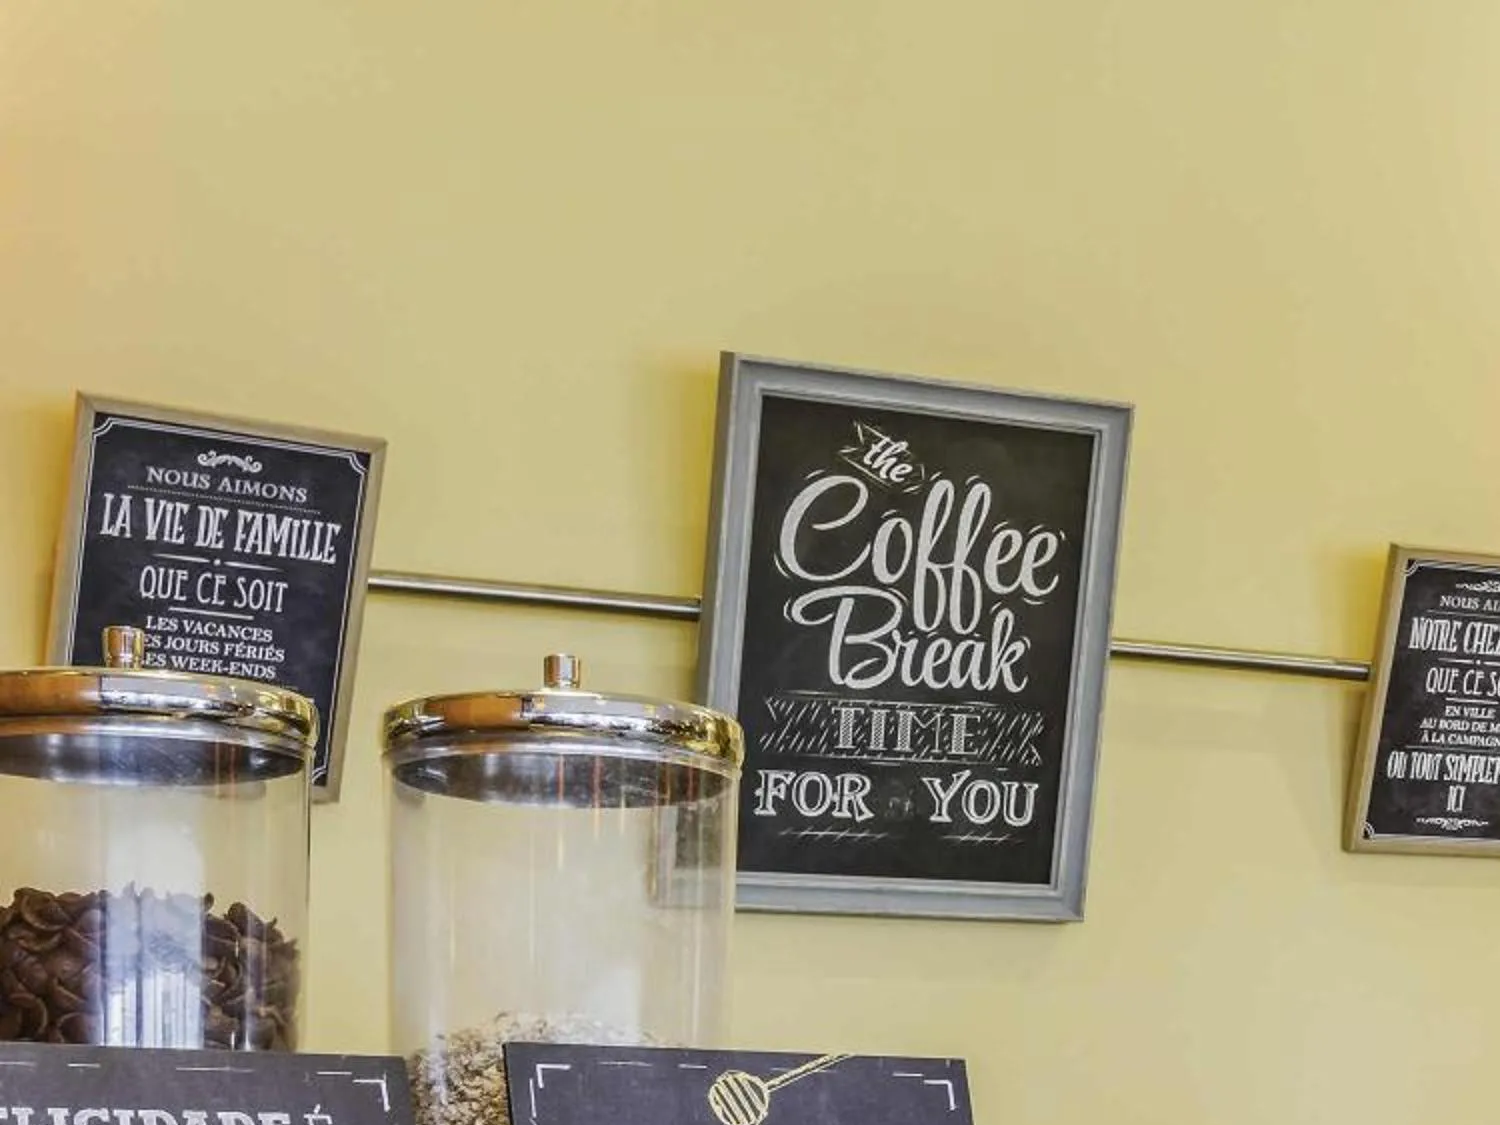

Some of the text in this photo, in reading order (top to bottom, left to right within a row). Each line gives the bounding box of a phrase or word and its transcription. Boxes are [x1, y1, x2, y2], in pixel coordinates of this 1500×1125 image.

[864, 434, 914, 483] the
[146, 466, 308, 503] NOUS AIMONS
[99, 493, 342, 564] LA VIE DE FAMILLE
[778, 475, 1059, 635] Coffee
[139, 565, 288, 613] QUE CE SOIT
[1440, 595, 1479, 610] NOUS
[145, 615, 273, 643] LES VACANCES
[791, 586, 1029, 692] Break
[1408, 617, 1462, 652] NOTRE
[144, 635, 285, 662] ES JOURS FÉRIÉS
[171, 655, 277, 679] WEEK-ENDS
[1426, 667, 1459, 694] QUE
[1463, 669, 1485, 694] CE
[1420, 717, 1437, 728] AU
[1439, 719, 1470, 730] BORD
[1471, 722, 1488, 732] DE
[1445, 705, 1496, 718] EN VILLE
[832, 706, 982, 755] TIME
[1431, 732, 1445, 744] LA
[755, 769, 1039, 826] FOR YOU
